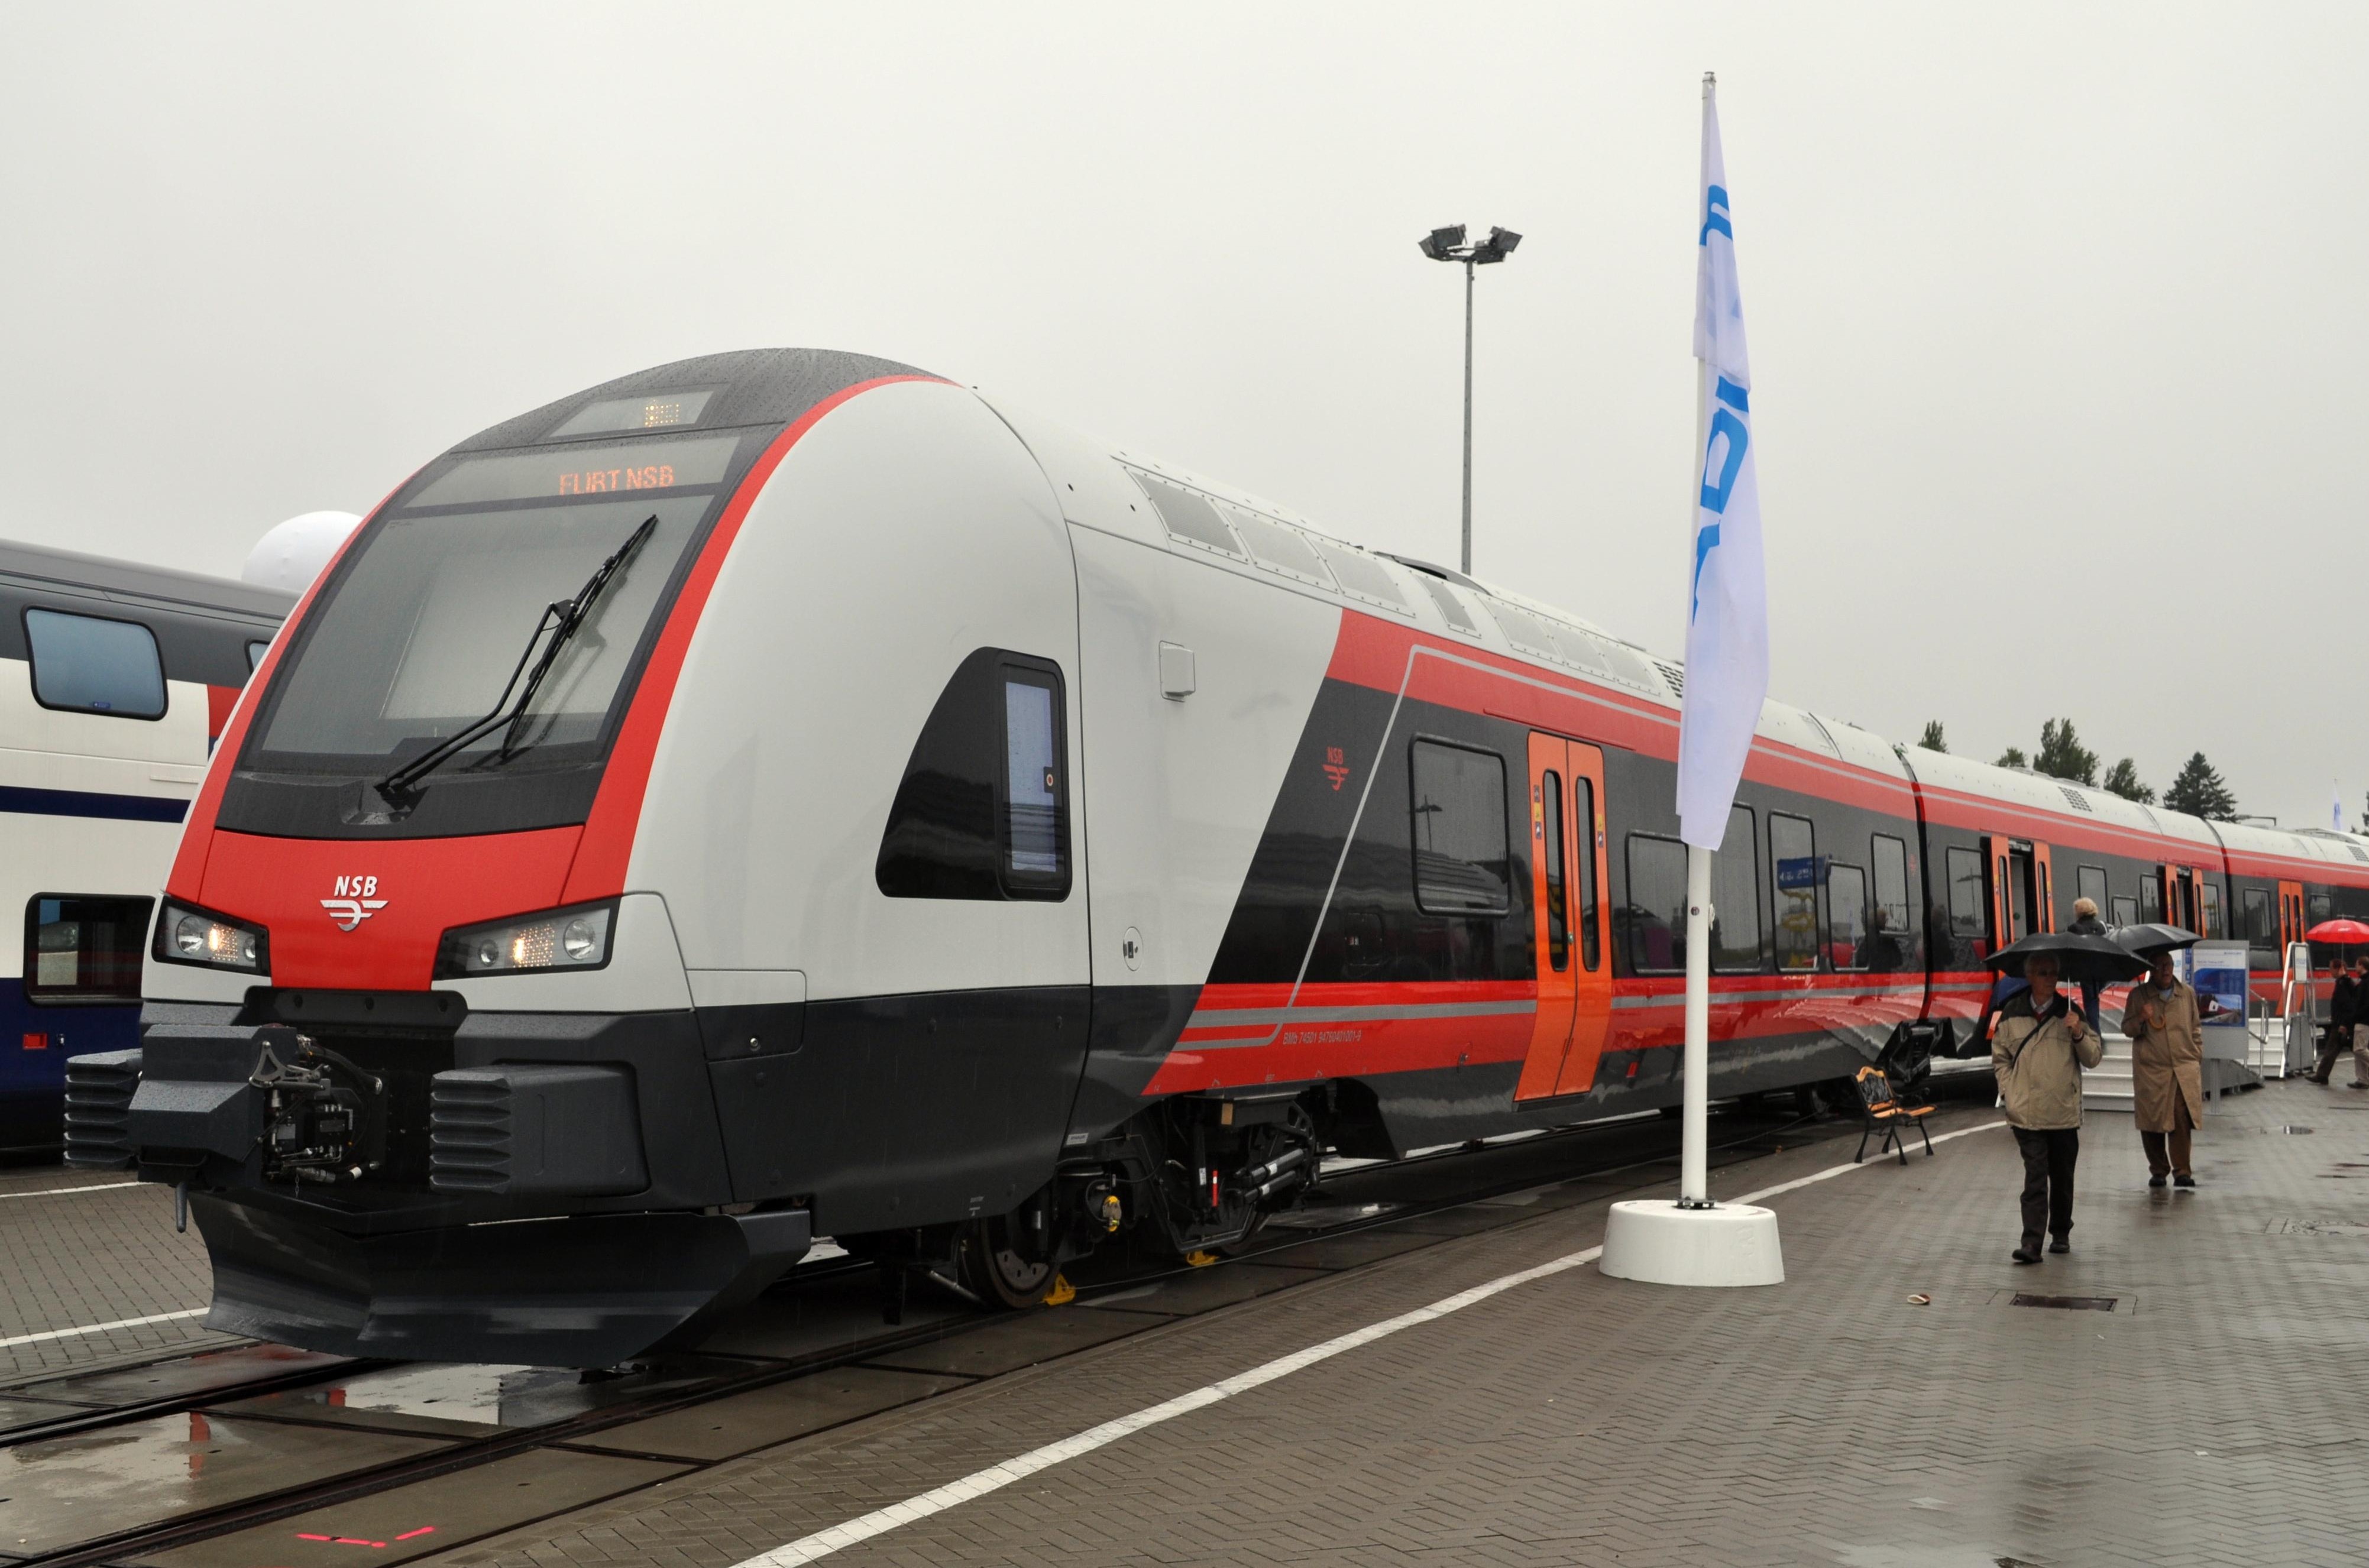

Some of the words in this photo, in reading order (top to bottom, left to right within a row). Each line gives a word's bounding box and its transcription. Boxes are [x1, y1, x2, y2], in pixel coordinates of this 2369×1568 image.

[559, 469, 620, 495] FLIRT
[626, 465, 674, 490] NSB
[1326, 746, 1344, 765] NSB
[334, 875, 378, 898] NSB
